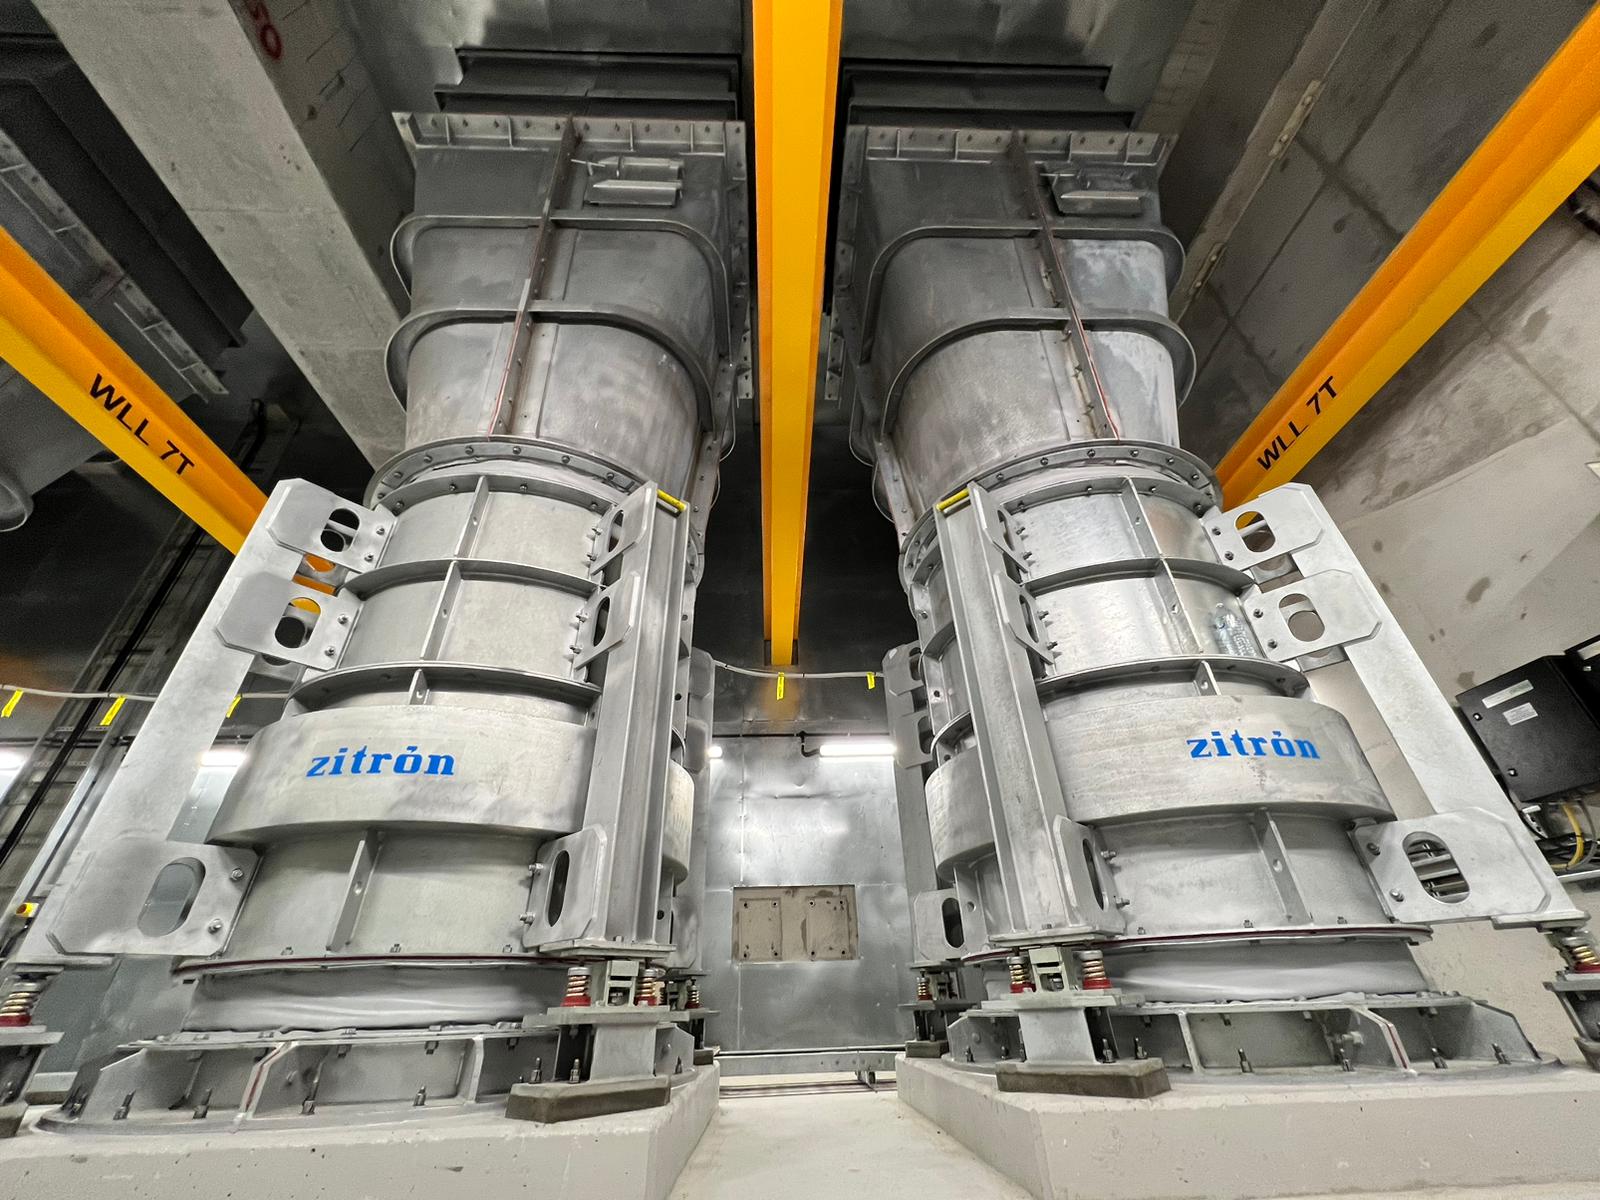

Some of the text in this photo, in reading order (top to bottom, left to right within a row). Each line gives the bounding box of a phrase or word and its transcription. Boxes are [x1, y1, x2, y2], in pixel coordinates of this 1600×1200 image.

[89, 372, 196, 476] WLL 7T
[1256, 375, 1338, 471] WLL 7T
[305, 744, 456, 778] zitrón
